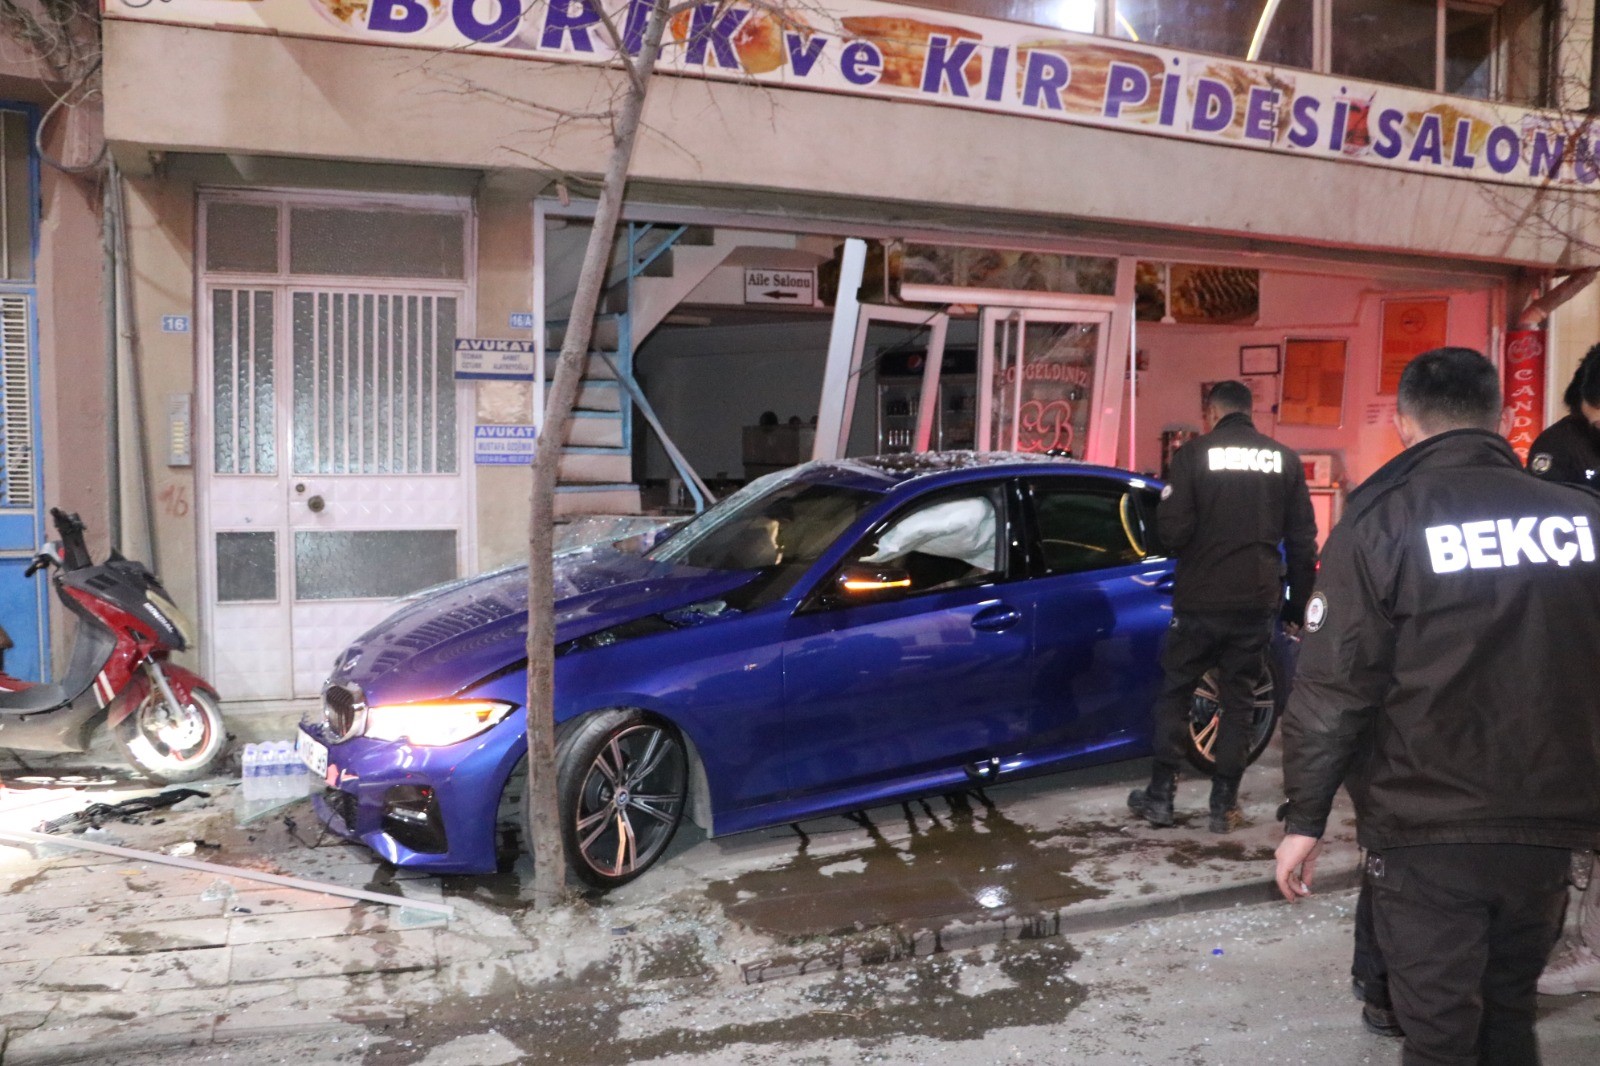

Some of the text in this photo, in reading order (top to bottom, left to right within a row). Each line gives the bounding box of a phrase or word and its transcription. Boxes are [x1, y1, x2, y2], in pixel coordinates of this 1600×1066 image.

[785, 34, 881, 85] ve
[921, 33, 1069, 110] KIR
[1104, 57, 1348, 151] PİDESİ
[748, 273, 810, 288] Aile Salonu
[166, 318, 184, 331] 16
[458, 340, 532, 352] AVUKAT
[476, 426, 534, 438] AVUKAT
